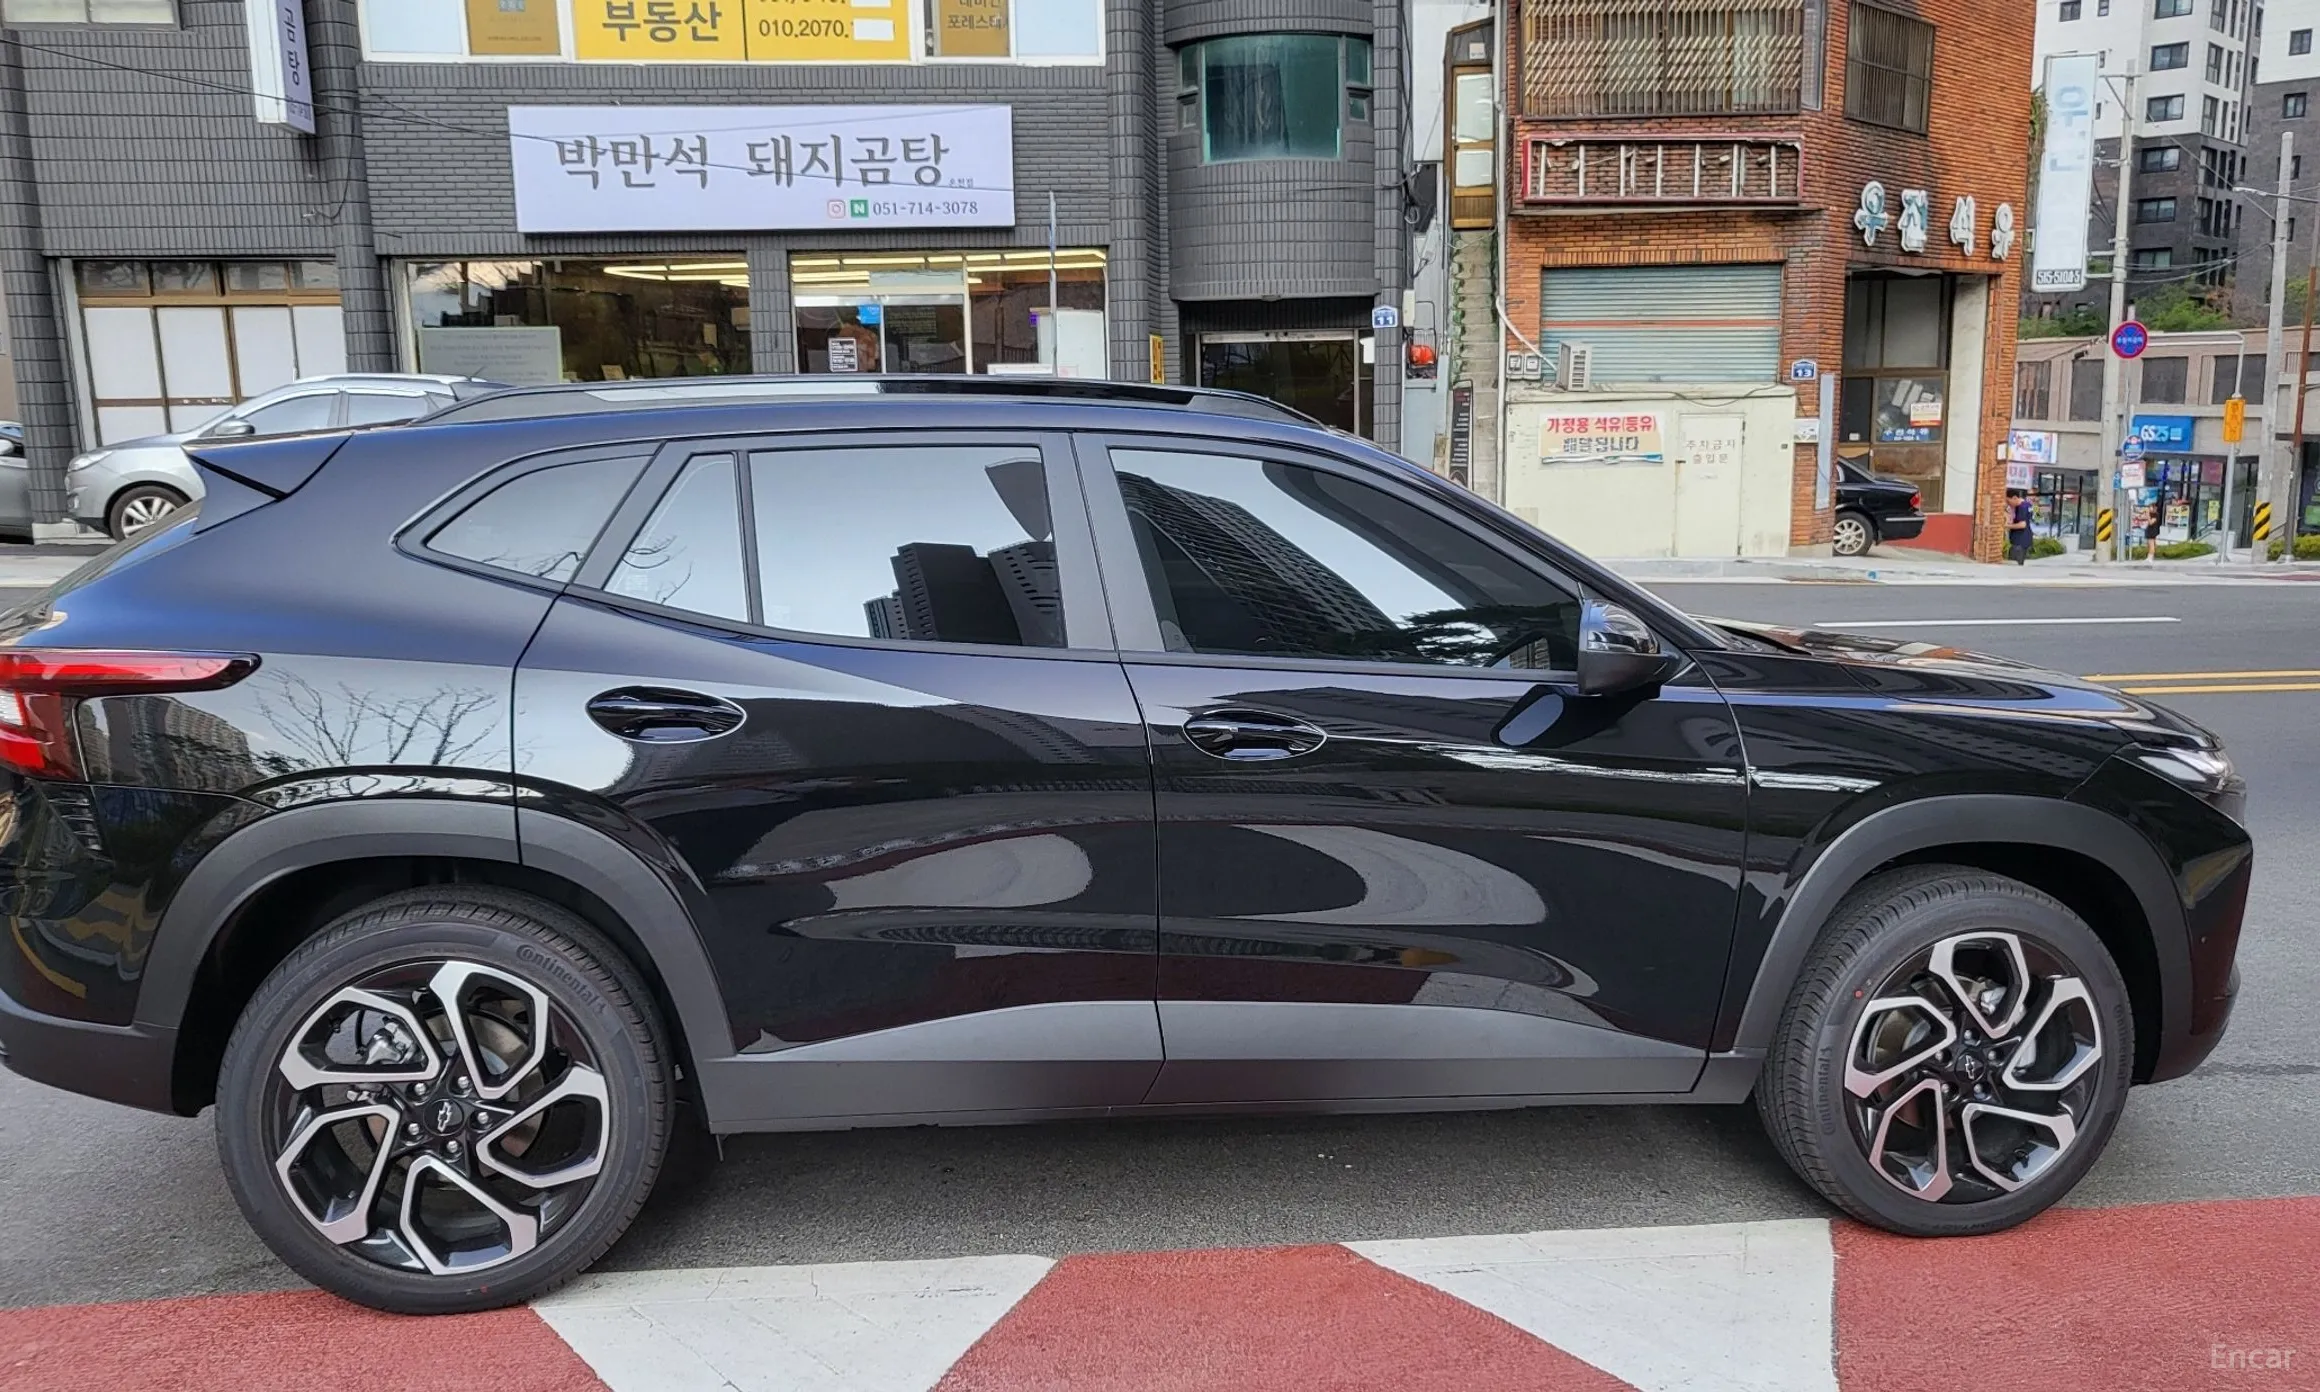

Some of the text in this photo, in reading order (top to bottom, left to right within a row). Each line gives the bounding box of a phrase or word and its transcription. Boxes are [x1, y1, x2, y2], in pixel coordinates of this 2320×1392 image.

[602, 0, 722, 43] 부동산
[554, 133, 950, 190] 박만석 돼지곰탕
[872, 201, 979, 216] 051-714-3078
[1376, 316, 1394, 325] 11
[1796, 369, 1812, 377] 13
[1546, 416, 1589, 434] 가정용
[2140, 424, 2170, 442] GS25
[515, 944, 600, 1007] Continental
[1817, 1057, 1836, 1135] Continental
